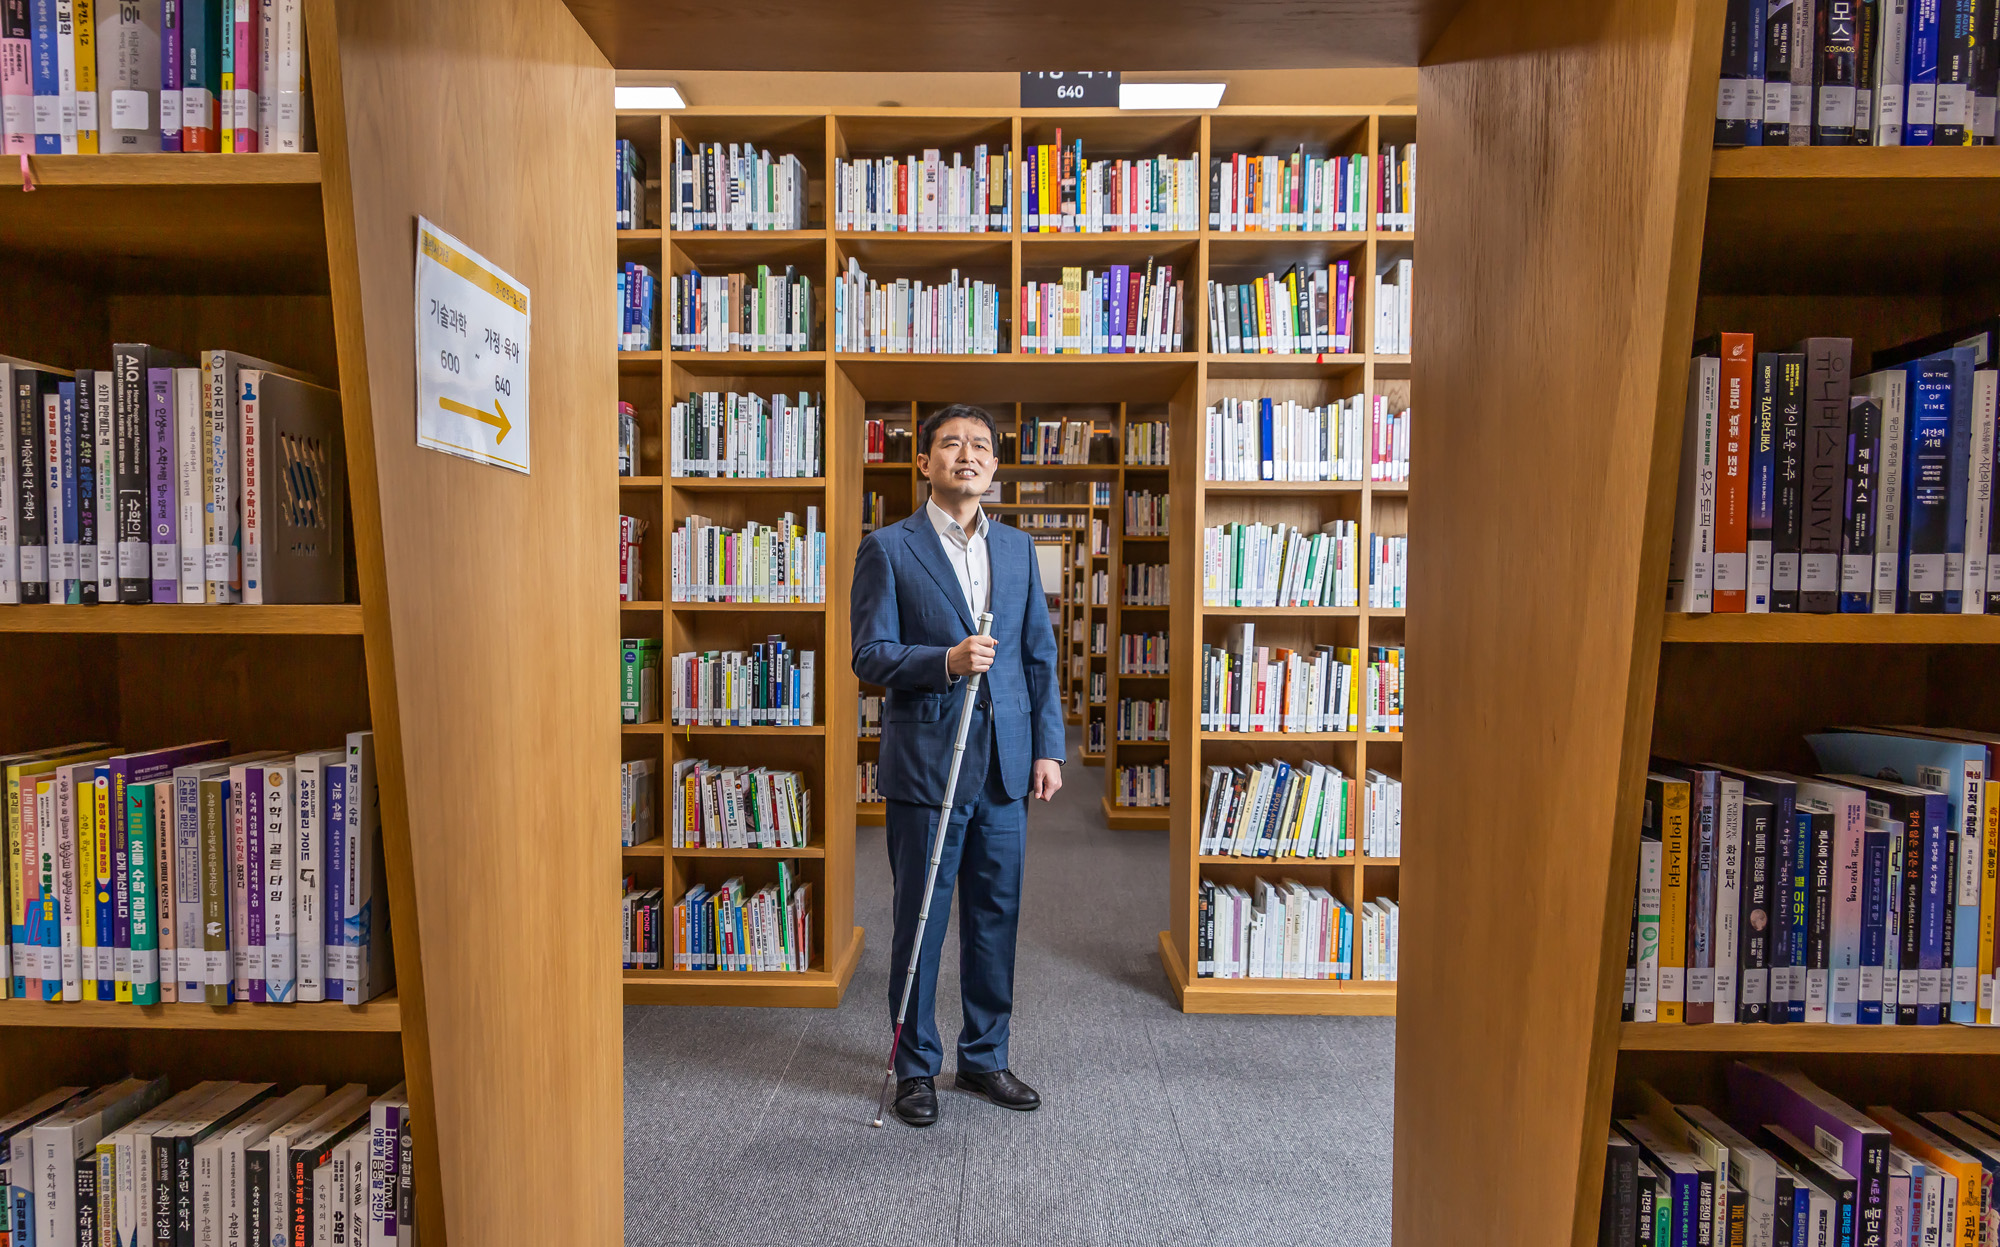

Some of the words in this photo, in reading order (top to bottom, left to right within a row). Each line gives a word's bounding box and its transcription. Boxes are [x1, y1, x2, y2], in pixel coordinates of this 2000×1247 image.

[1831, 3, 1851, 41] 모스
[1954, 15, 1962, 39] RIFKIN
[1057, 85, 1084, 98] 640
[431, 298, 467, 338] 기술과학
[127, 355, 140, 381] AIQ
[441, 350, 460, 374] 600
[98, 384, 109, 402] 숫자가
[495, 374, 511, 397] 640
[1729, 378, 1741, 409] 날마다
[204, 383, 213, 428] 알지오매스
[213, 373, 224, 433] 지오지브라
[245, 404, 253, 423] 어느
[1812, 351, 1844, 459] 유니버스
[99, 404, 110, 436] 만만해지는
[158, 408, 168, 443] 인생에도
[1728, 414, 1740, 438] 우주
[1783, 404, 1798, 451] 경이로운
[1889, 417, 1899, 440] 우리가
[1921, 428, 1945, 437] 시간의
[100, 438, 110, 446] 책
[1727, 442, 1738, 452] 한
[1924, 439, 1941, 448] 기원
[22, 439, 34, 477] 미술관에
[158, 447, 168, 480] 수학처럼
[213, 436, 226, 475] 무작정
[1727, 455, 1738, 477] 조각
[1888, 443, 1898, 467] 우주에
[246, 449, 255, 488] 선생님의
[1782, 456, 1796, 481] 우주
[1856, 448, 1870, 502] 제네시스
[1887, 471, 1897, 485] 가야
[1979, 456, 1991, 482] 시간의
[24, 479, 34, 488] 간
[158, 484, 168, 497] 답이
[215, 477, 226, 512] 따라하기
[1701, 468, 1713, 496] 우주
[1978, 484, 1990, 501] 역사
[24, 491, 36, 520] 수학자
[1886, 487, 1896, 503] 하는
[127, 499, 141, 534] 수학의
[158, 500, 168, 519] 있다면
[247, 490, 256, 529] 수학사전
[1700, 499, 1711, 527] 토픽
[1885, 505, 1895, 521] 이유
[311, 780, 315, 789] NO
[350, 764, 359, 783] 개념
[1966, 771, 1981, 779] 핵심
[10, 792, 19, 811] 생각을
[23, 789, 33, 803] 나의
[180, 780, 188, 811] 스탠퍼드
[188, 781, 196, 803] 수학이
[234, 782, 243, 815] 지금까지
[301, 780, 310, 829] 수학&물리
[332, 783, 342, 801] 기초
[23, 806, 34, 830] 하버드
[269, 792, 283, 834] 수학의
[332, 803, 342, 822] 수학
[350, 808, 359, 827] 수학
[1702, 806, 1712, 832] 행성을
[1909, 811, 1920, 828] 검지
[1966, 782, 1978, 838] 지적측량학
[180, 815, 188, 845] 마인드셋
[188, 807, 197, 839] 좋아지는
[236, 818, 243, 834] 이런
[1670, 815, 1682, 839] 달의
[1756, 818, 1766, 831] 나는
[12, 840, 20, 855] 수학
[24, 832, 35, 847] 수학
[236, 837, 244, 862] 수학은
[301, 832, 310, 861] 가이드
[1755, 834, 1765, 853] 어쩌다
[1818, 830, 1828, 857] 메시에
[1908, 830, 1919, 848] 않은
[25, 849, 36, 865] 시간
[116, 852, 126, 870] 쉽게
[131, 840, 143, 866] 초등
[1668, 842, 1681, 887] 미스터리
[1700, 836, 1711, 871] 기록하다
[1725, 845, 1736, 866] 화성
[1908, 851, 1918, 868] 깊은
[132, 869, 145, 894] 수학
[237, 865, 245, 889] 없었다
[270, 843, 284, 902] 골든타임
[1725, 869, 1736, 889] 탐사
[1754, 857, 1765, 883] 명왕성을
[1817, 860, 1827, 886] 가이드
[1845, 862, 1858, 884] 별자리
[1907, 870, 1918, 879] 산
[117, 873, 128, 918] 계산합니다
[1846, 886, 1857, 902] 여행
[133, 897, 146, 936] 공부법
[1793, 891, 1804, 926] 이야기
[373, 1128, 385, 1157] 어떻게
[385, 1128, 398, 1157] How
[178, 1158, 190, 1192] 간추린
[296, 1162, 304, 1185] 미치도록
[372, 1160, 384, 1189] 증명할
[385, 1160, 394, 1171] to
[402, 1151, 411, 1188] 집합론
[47, 1164, 57, 1210] 수학사대전
[103, 1179, 110, 1192] 관한
[354, 1162, 362, 1206] 슬기로운
[384, 1174, 396, 1208] Prove
[1619, 1162, 1632, 1204] 엘리건트
[1869, 1178, 1880, 1204] 새로운
[1914, 1176, 1922, 1200] 세상을
[103, 1194, 111, 1227] 어마어마한
[157, 1183, 170, 1215] 수학사
[372, 1193, 383, 1222] 것인가
[1642, 1189, 1652, 1212] 시간의
[1700, 1182, 1711, 1220] 세상물정의
[178, 1196, 190, 1231] 수학사
[275, 1216, 283, 1230] 수학
[295, 1207, 305, 1222] 수학
[384, 1211, 396, 1220] It
[1732, 1205, 1744, 1220] THE
[1842, 1205, 1851, 1234] 물리학은
[1912, 1202, 1921, 1233] 움직이는
[157, 1217, 171, 1239] 강의
[201, 1216, 211, 1242] 수학의
[229, 1213, 239, 1238] 수학의
[319, 1224, 326, 1240] 지도
[334, 1211, 344, 1244] 수학은
[1641, 1214, 1651, 1240] 물리학
[1700, 1222, 1711, 1246] 물리학
[1760, 1212, 1770, 1239] 하늘과
